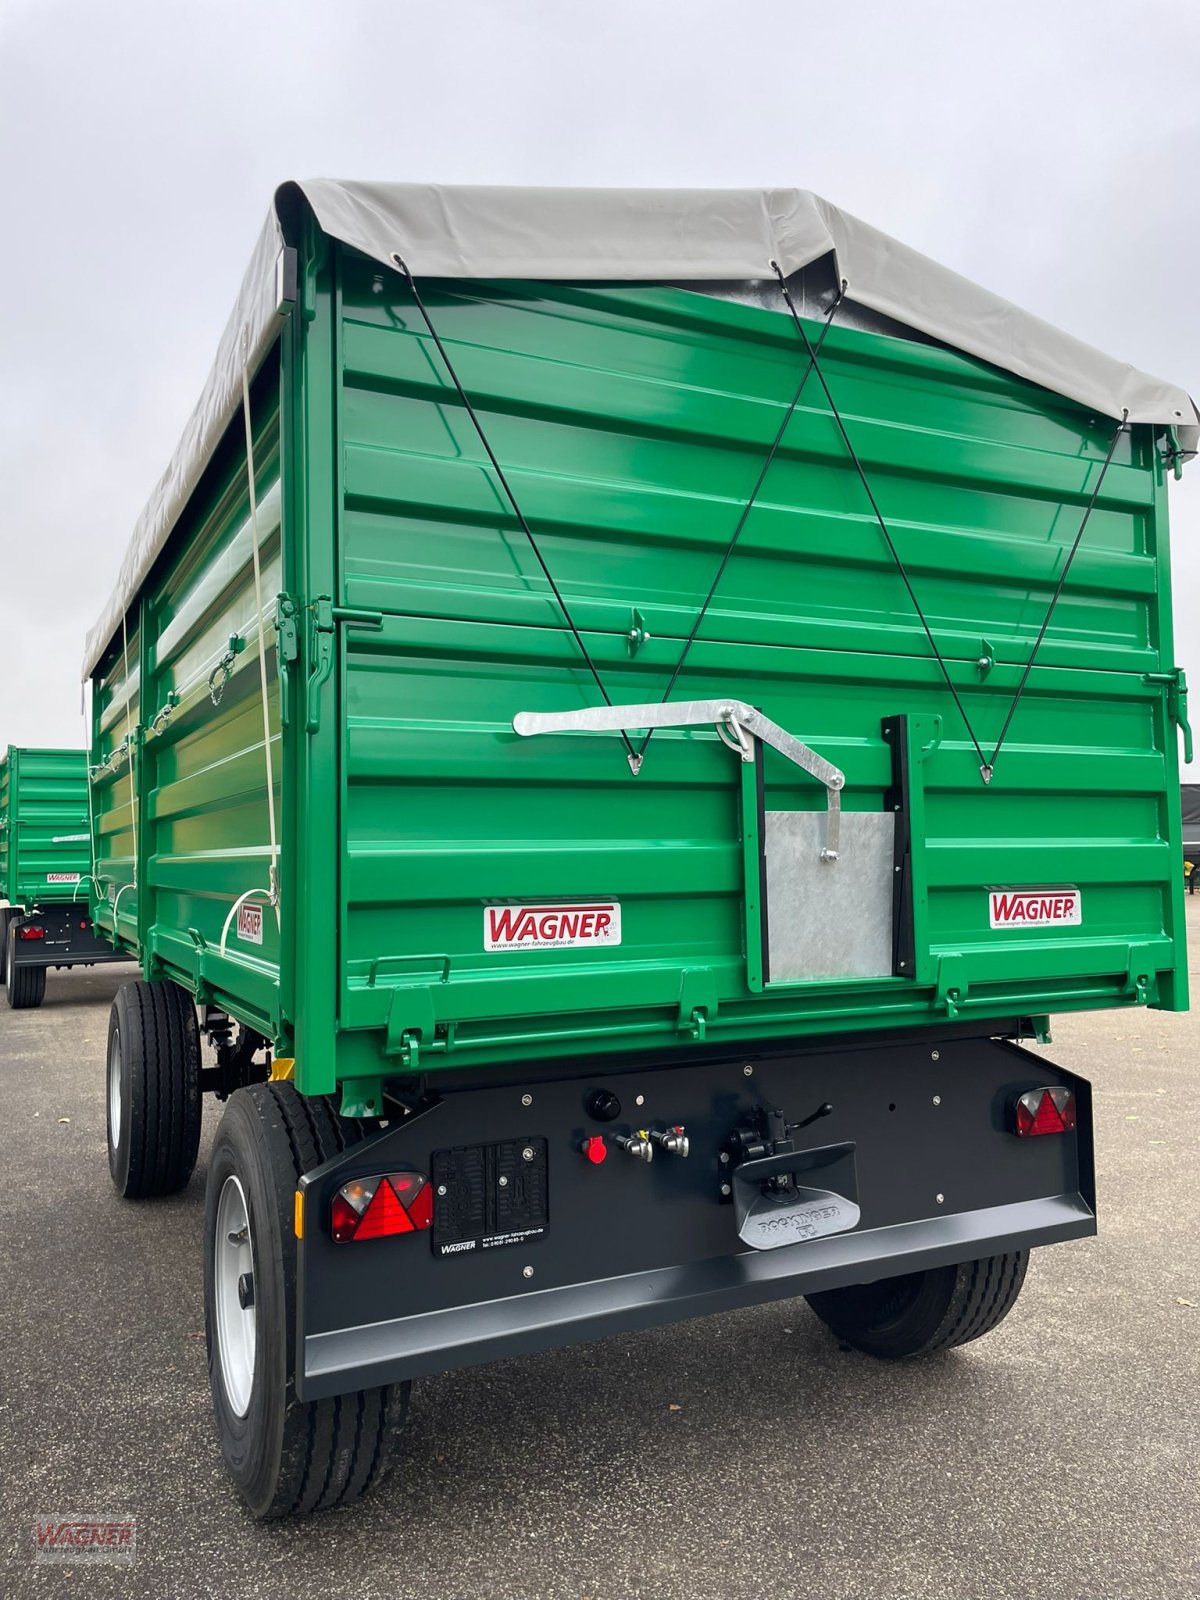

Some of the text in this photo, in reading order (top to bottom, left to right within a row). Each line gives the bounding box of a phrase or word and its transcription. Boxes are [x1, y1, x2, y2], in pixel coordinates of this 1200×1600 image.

[48, 873, 77, 881] WAGNER
[238, 905, 261, 935] WAGNER
[992, 893, 1076, 921] WAGNER
[490, 906, 614, 942] WAGNER
[491, 938, 575, 949] www.wagner-fahrzeugbau.de
[757, 1206, 840, 1233] ROCKINGER
[441, 1241, 476, 1254] WAGNER
